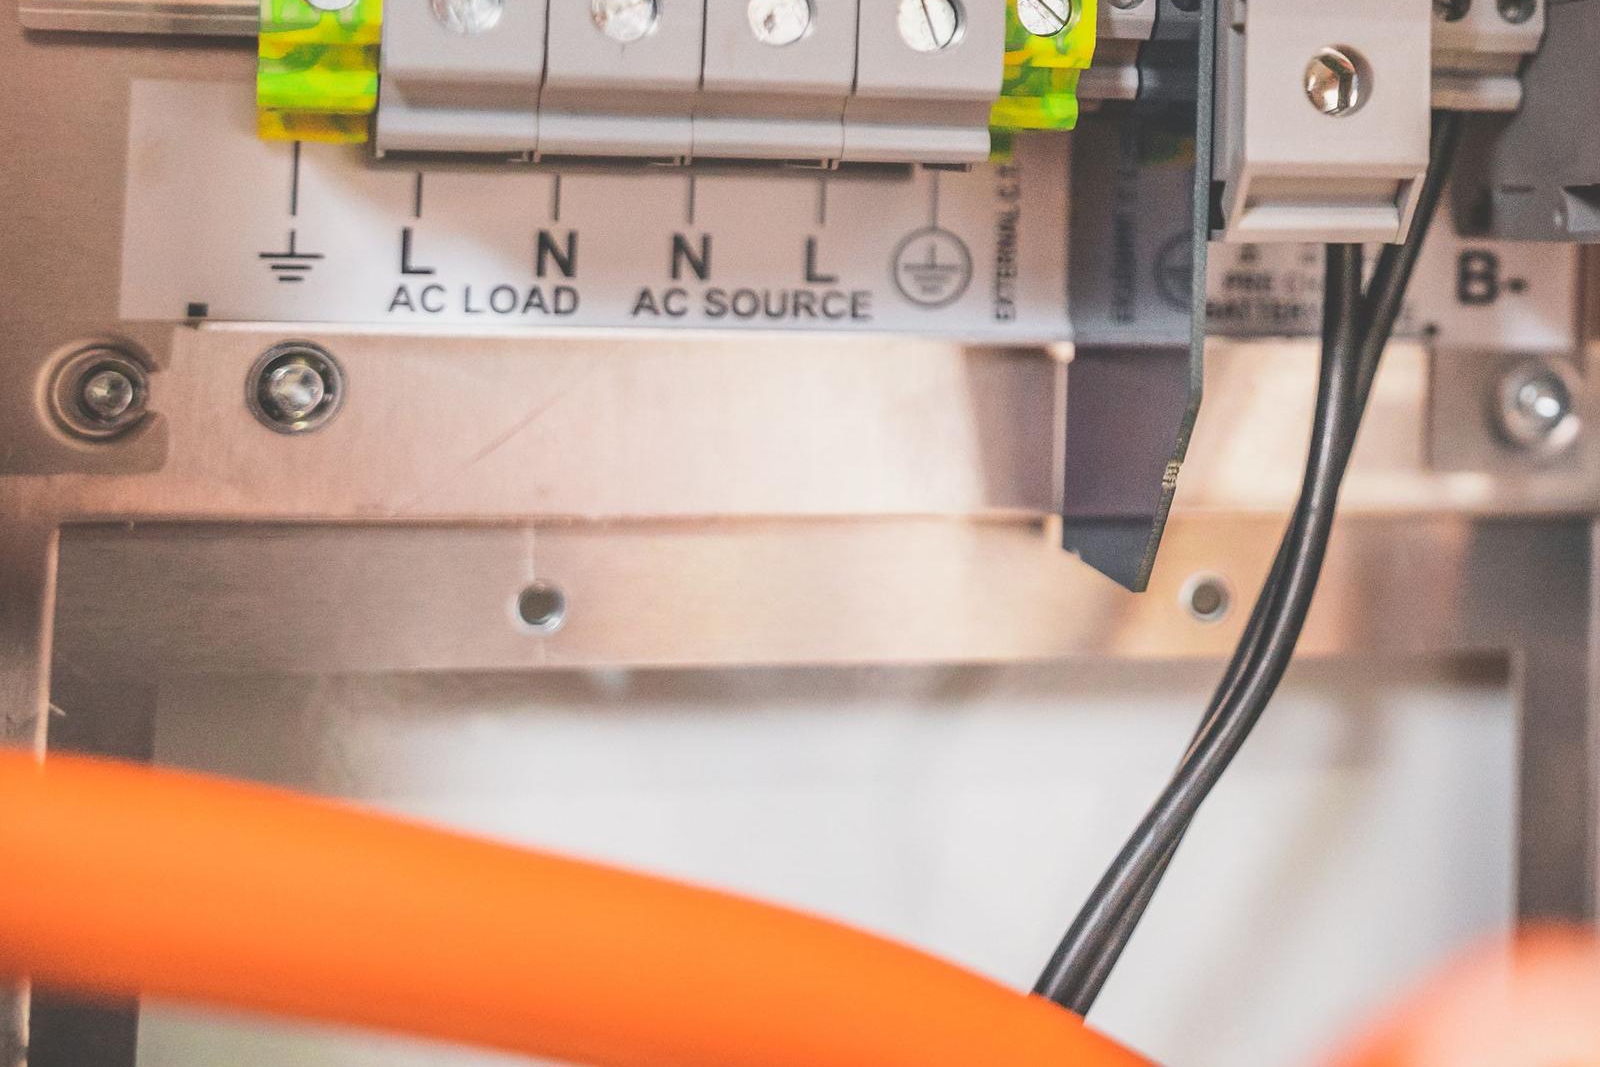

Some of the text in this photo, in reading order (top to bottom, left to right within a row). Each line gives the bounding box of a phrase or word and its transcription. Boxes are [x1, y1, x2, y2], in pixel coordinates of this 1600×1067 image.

[400, 227, 838, 283] L N N L
[389, 285, 580, 316] AC LOAD
[634, 289, 873, 321] AC SOURCE
